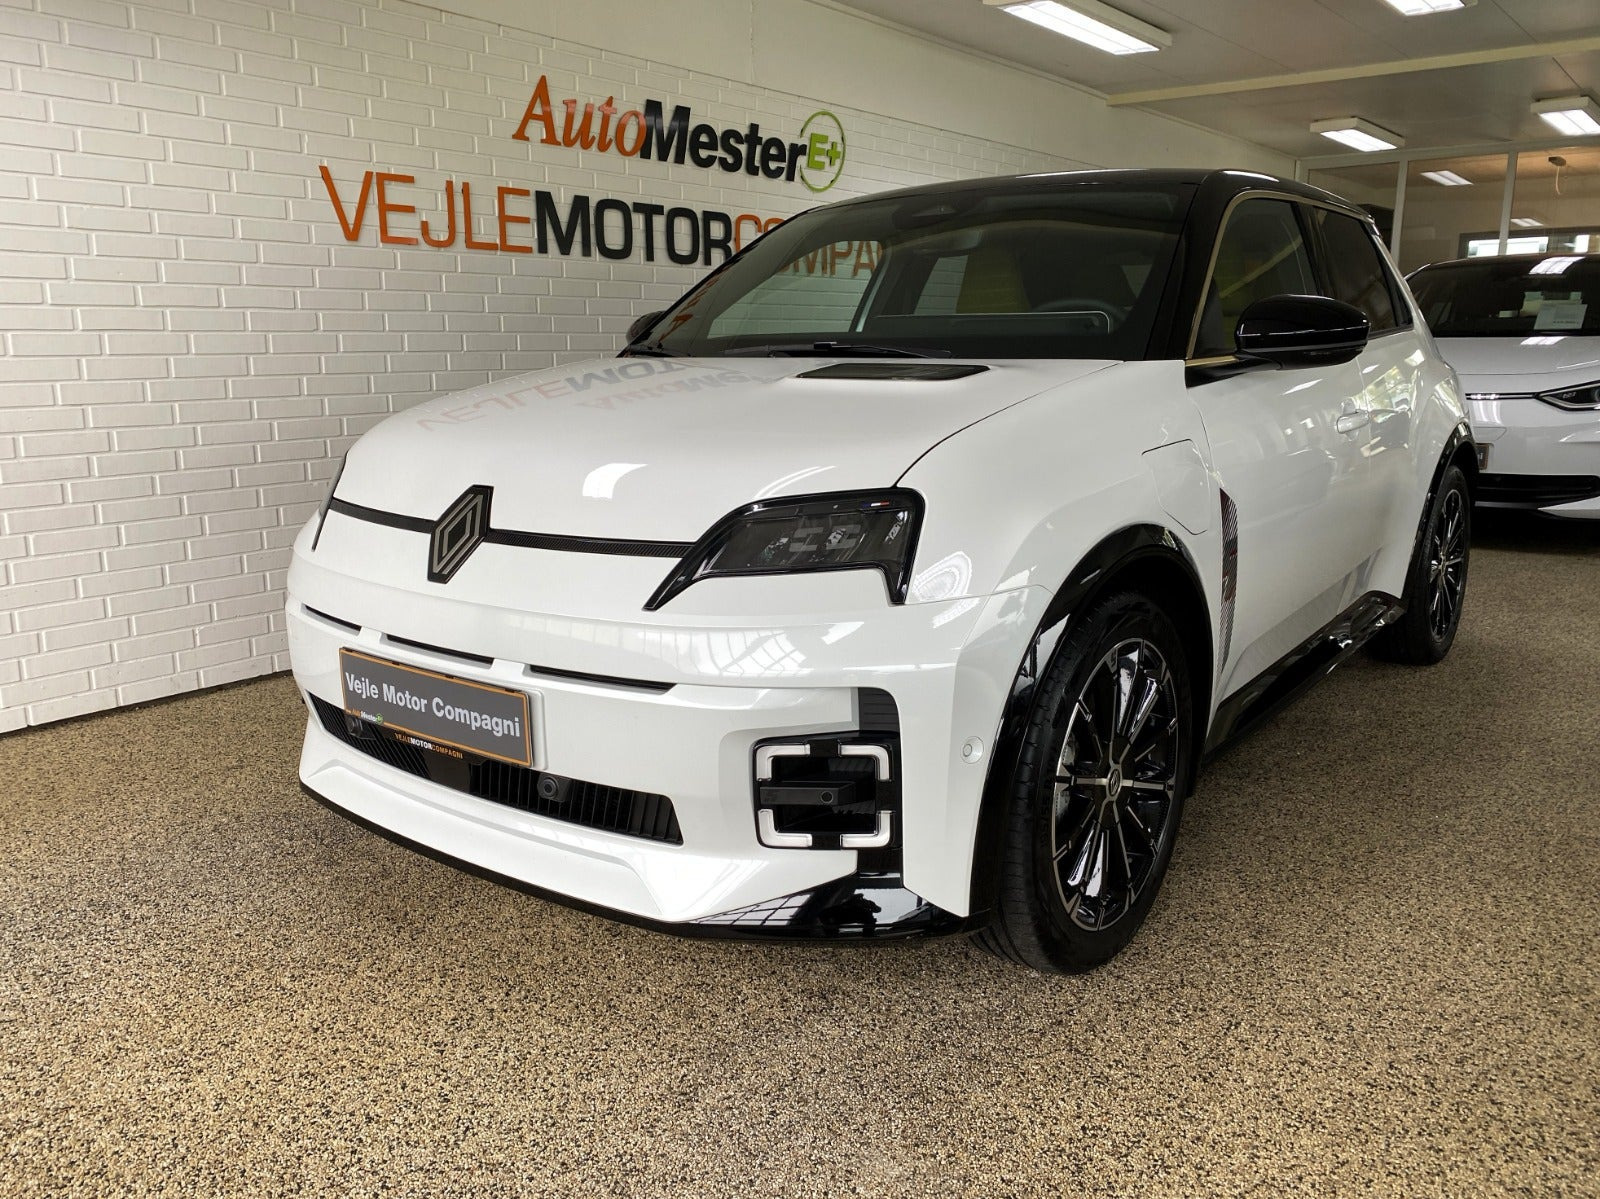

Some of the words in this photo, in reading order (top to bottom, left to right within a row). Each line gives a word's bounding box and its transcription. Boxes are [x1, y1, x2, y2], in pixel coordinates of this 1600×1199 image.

[511, 74, 807, 182] AutoMester
[345, 672, 379, 699] Vejle
[382, 683, 428, 713] Motor
[432, 697, 521, 738] Compagni
